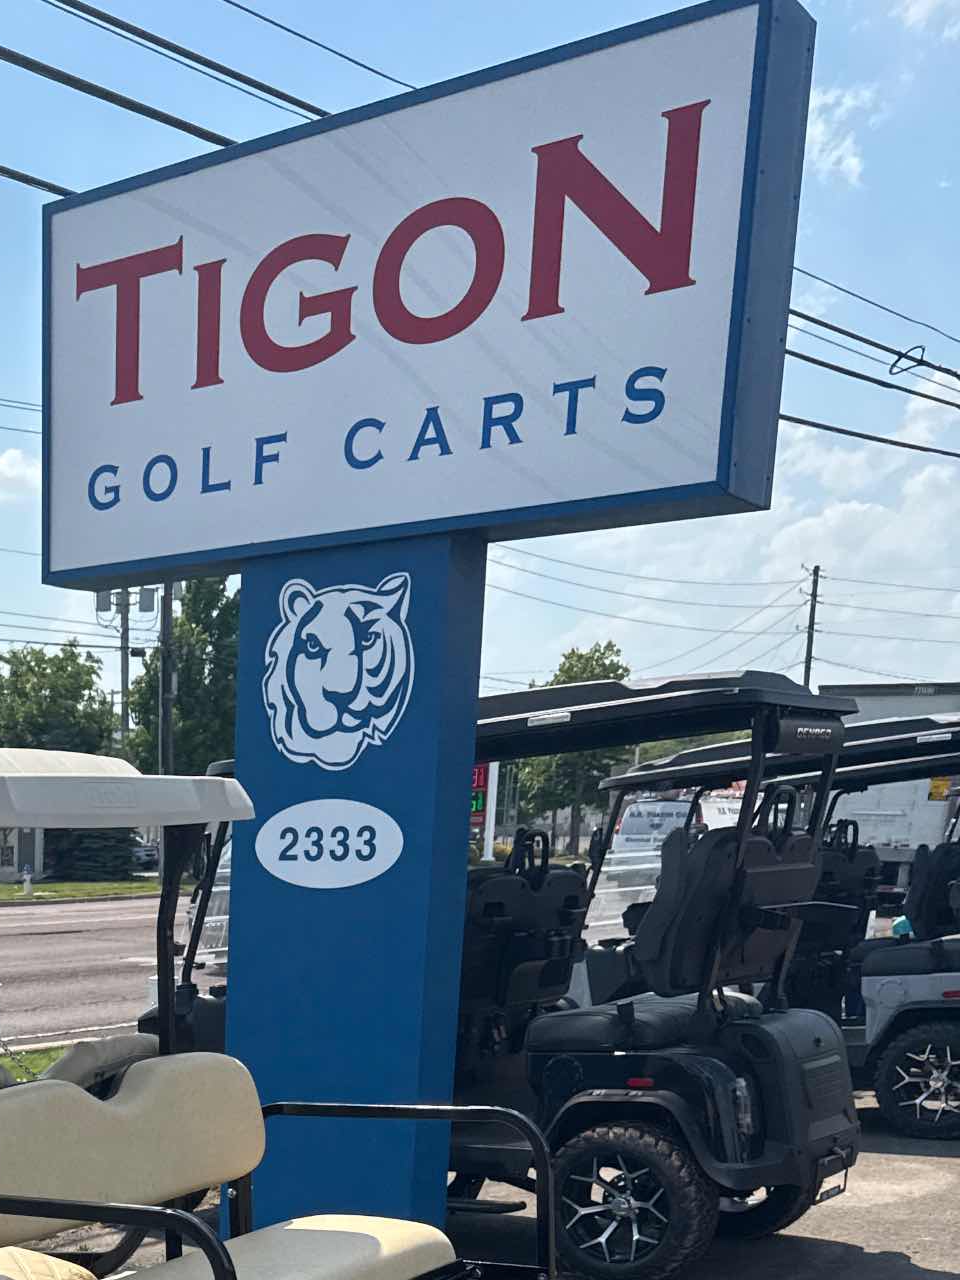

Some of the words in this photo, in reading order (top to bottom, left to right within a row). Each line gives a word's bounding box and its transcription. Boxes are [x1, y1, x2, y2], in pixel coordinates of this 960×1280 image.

[76, 99, 712, 406] TIGON
[87, 431, 288, 511] GOLF
[344, 366, 668, 470] CARTS
[278, 825, 377, 862] 2333
